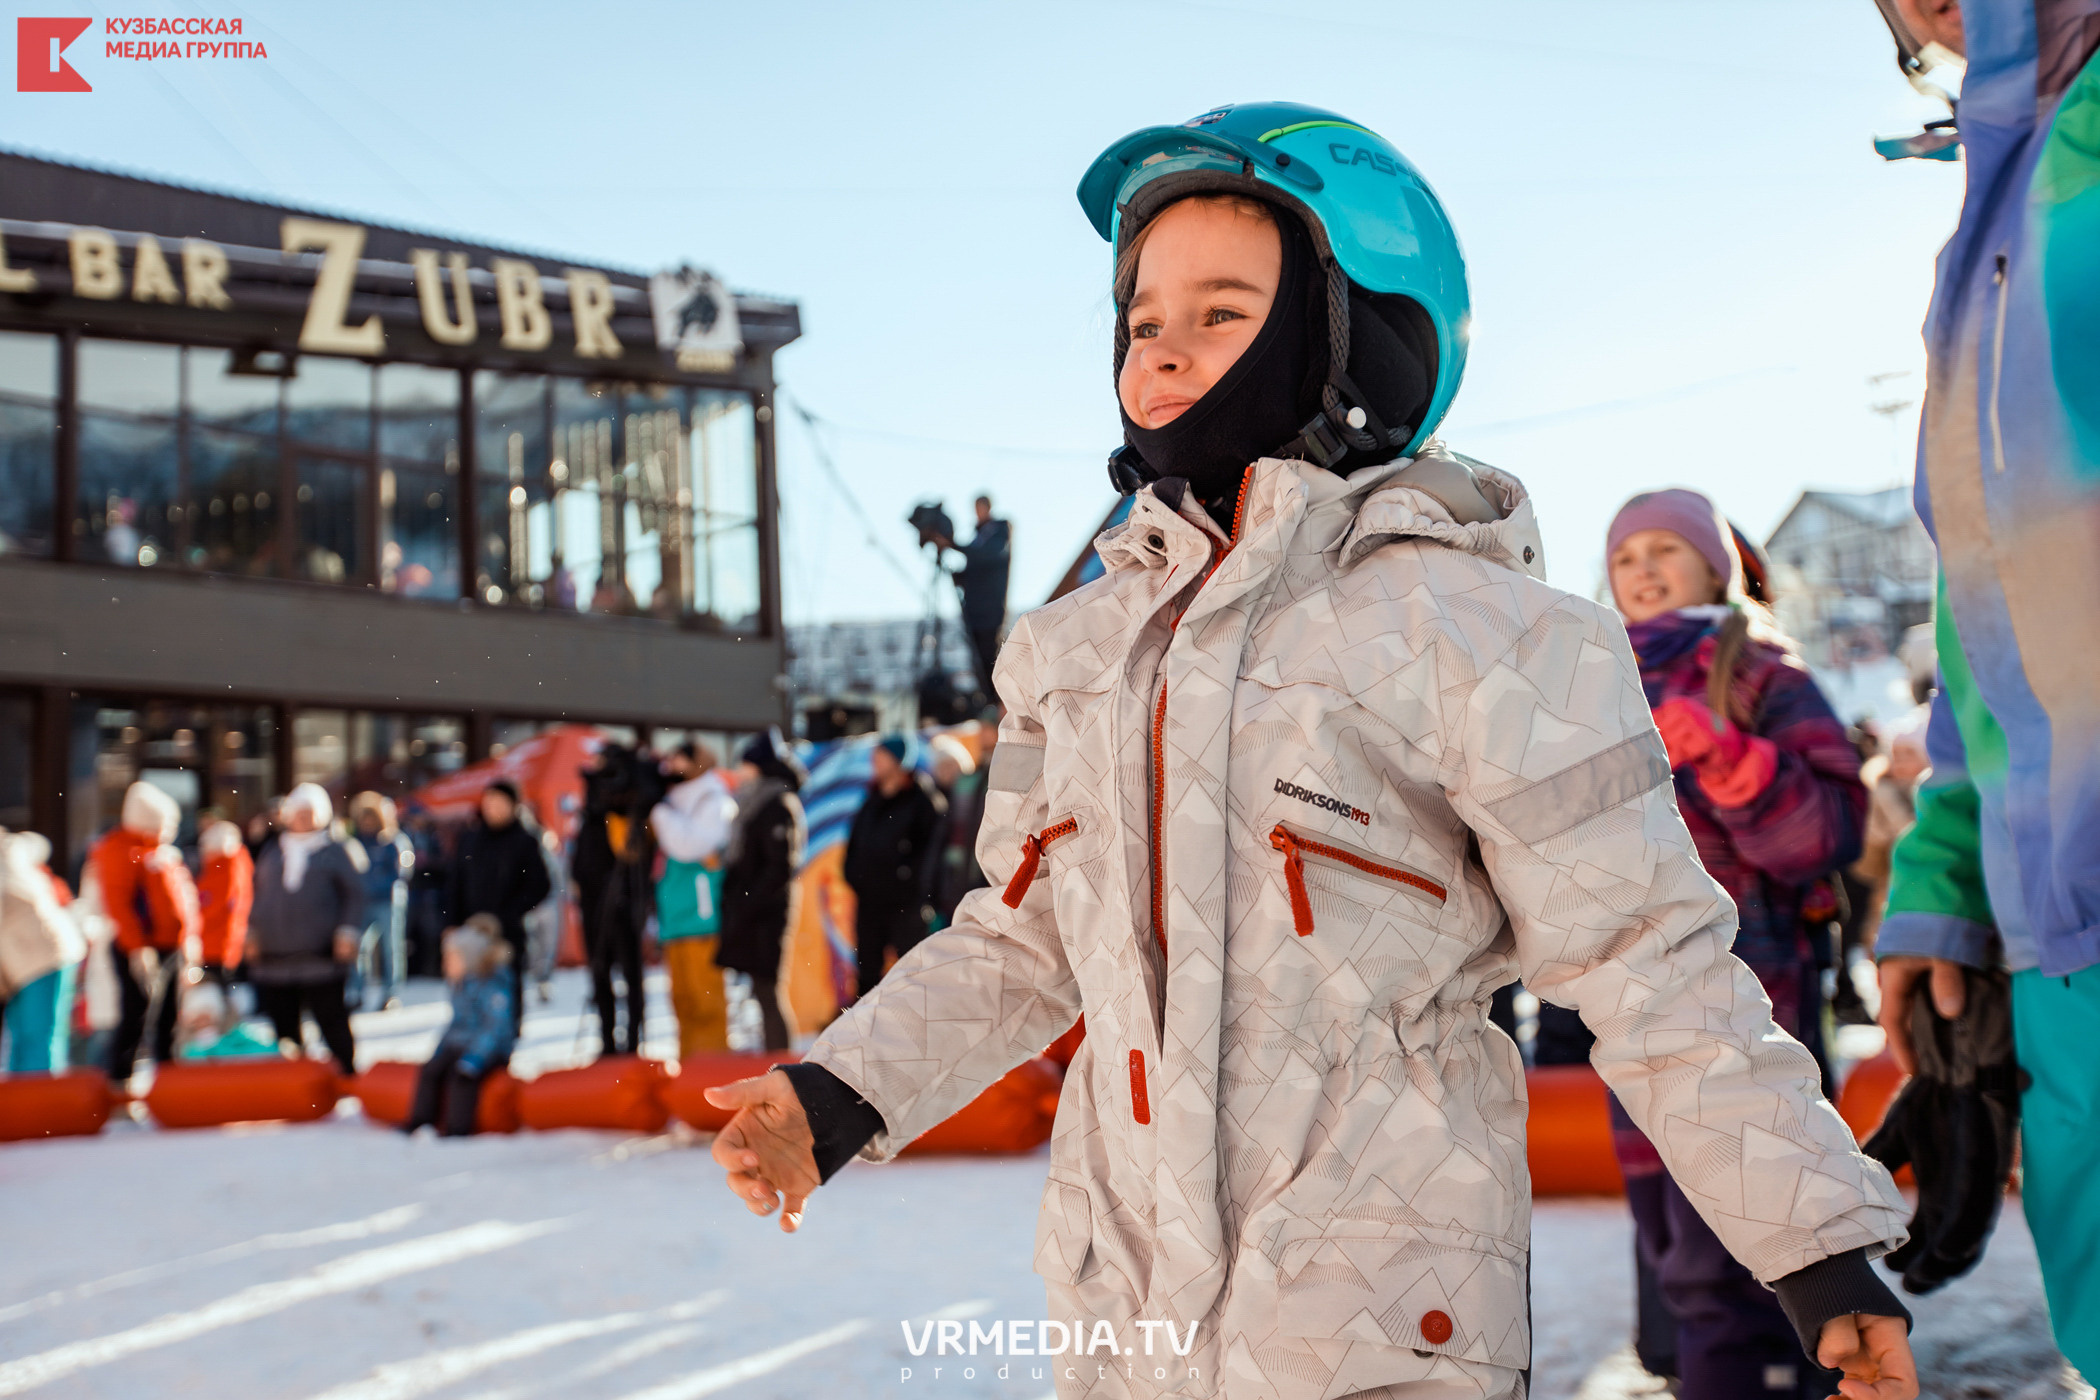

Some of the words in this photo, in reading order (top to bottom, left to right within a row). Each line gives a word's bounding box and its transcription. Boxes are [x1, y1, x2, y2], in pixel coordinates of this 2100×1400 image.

[1328, 143, 1424, 190] CAS
[68, 229, 231, 310] BAR
[280, 216, 624, 359] ZUBR
